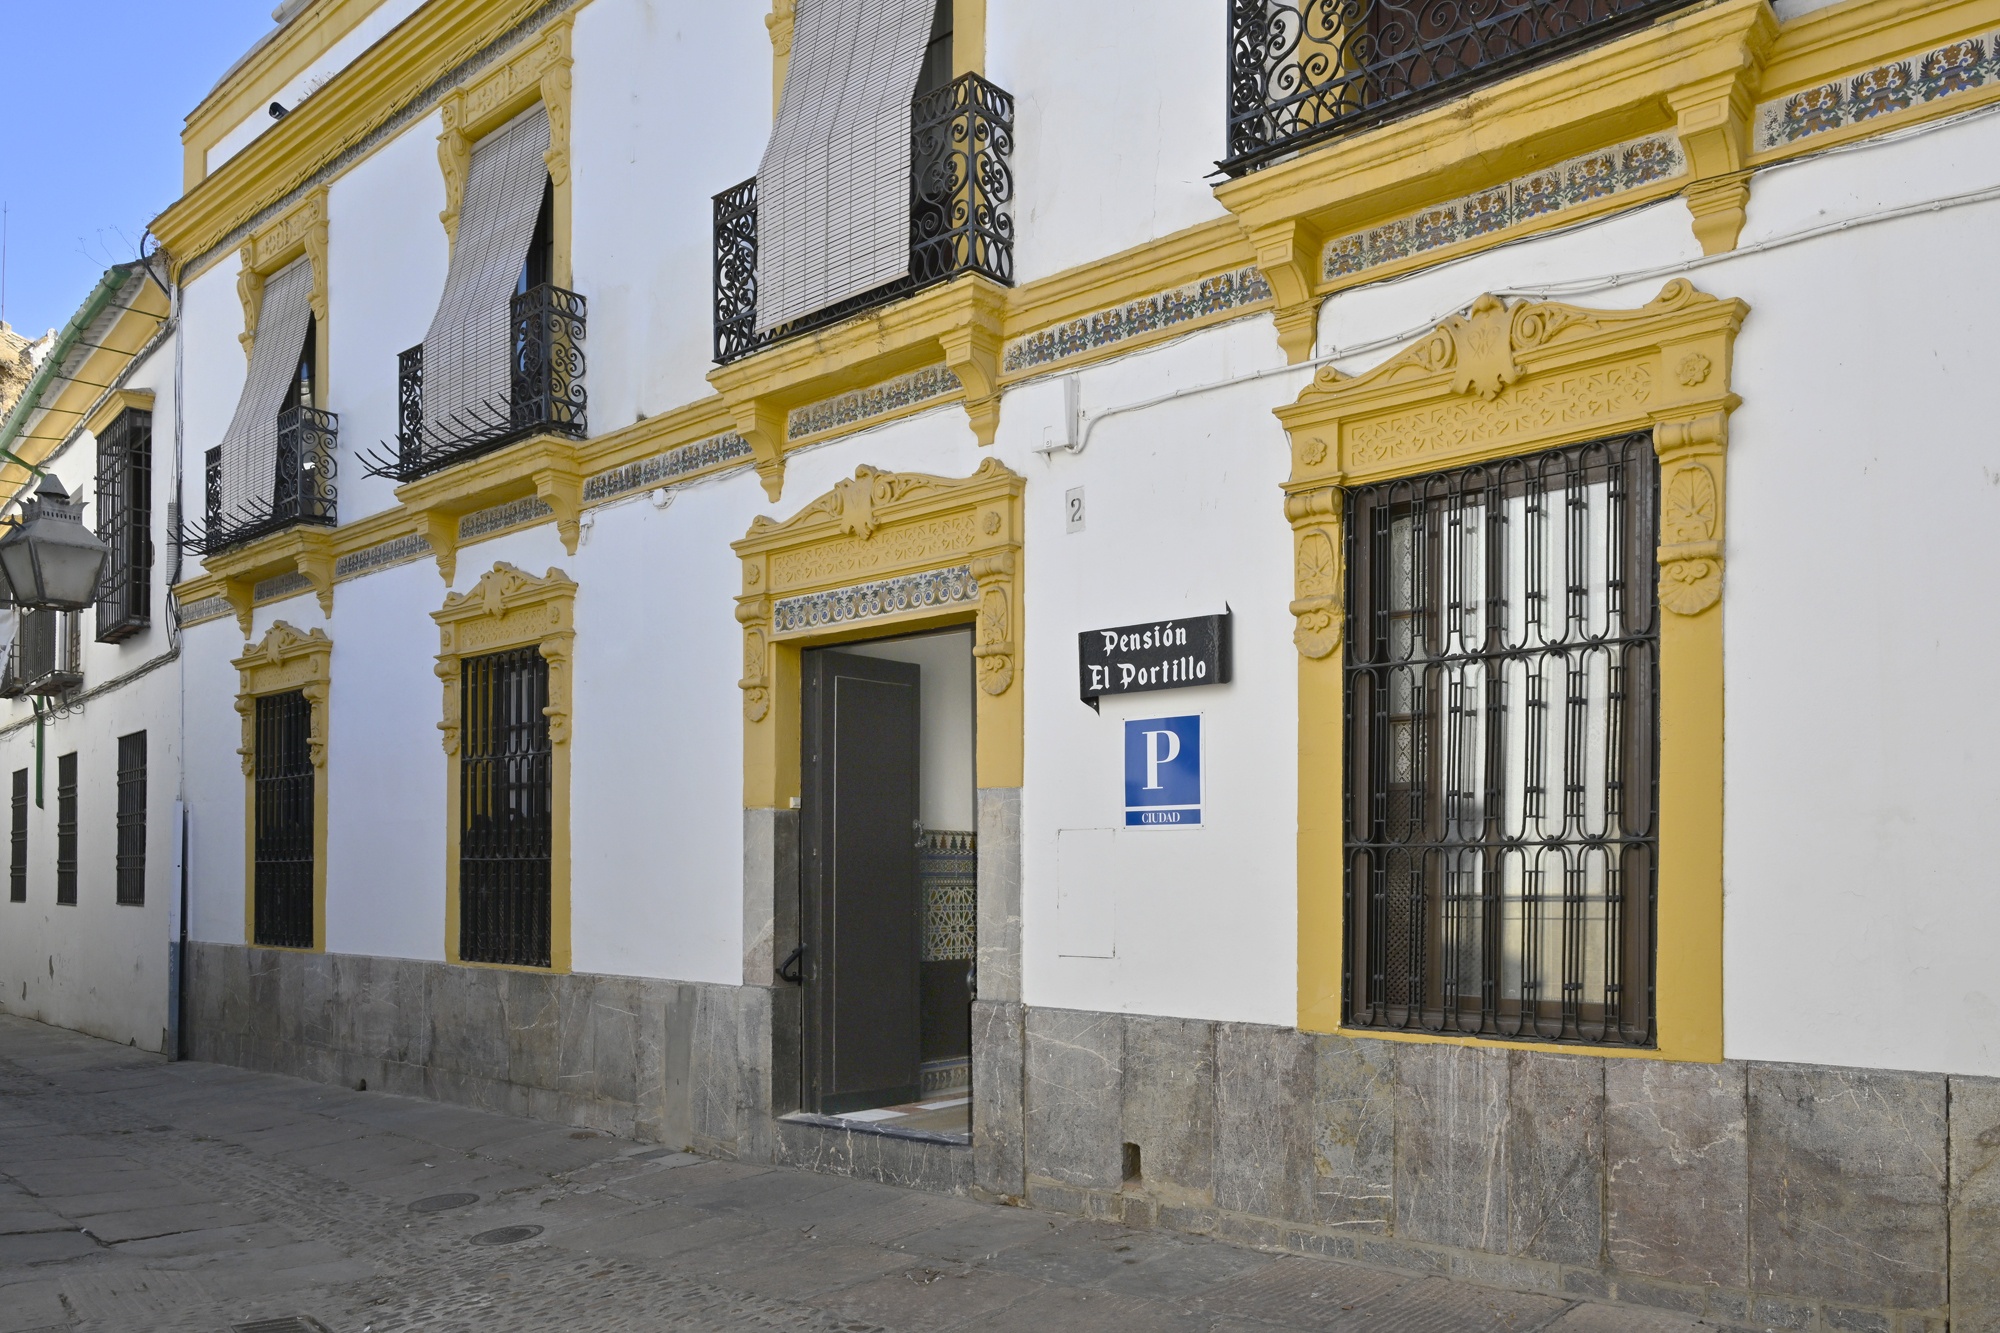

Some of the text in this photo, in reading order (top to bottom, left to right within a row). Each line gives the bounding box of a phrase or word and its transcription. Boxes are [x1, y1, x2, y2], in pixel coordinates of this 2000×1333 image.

[1071, 498, 1082, 522] 2
[1100, 622, 1187, 656] Pensión
[1087, 656, 1206, 691] El Portillo
[1142, 730, 1180, 790] P
[1141, 812, 1180, 823] CIUDAD
